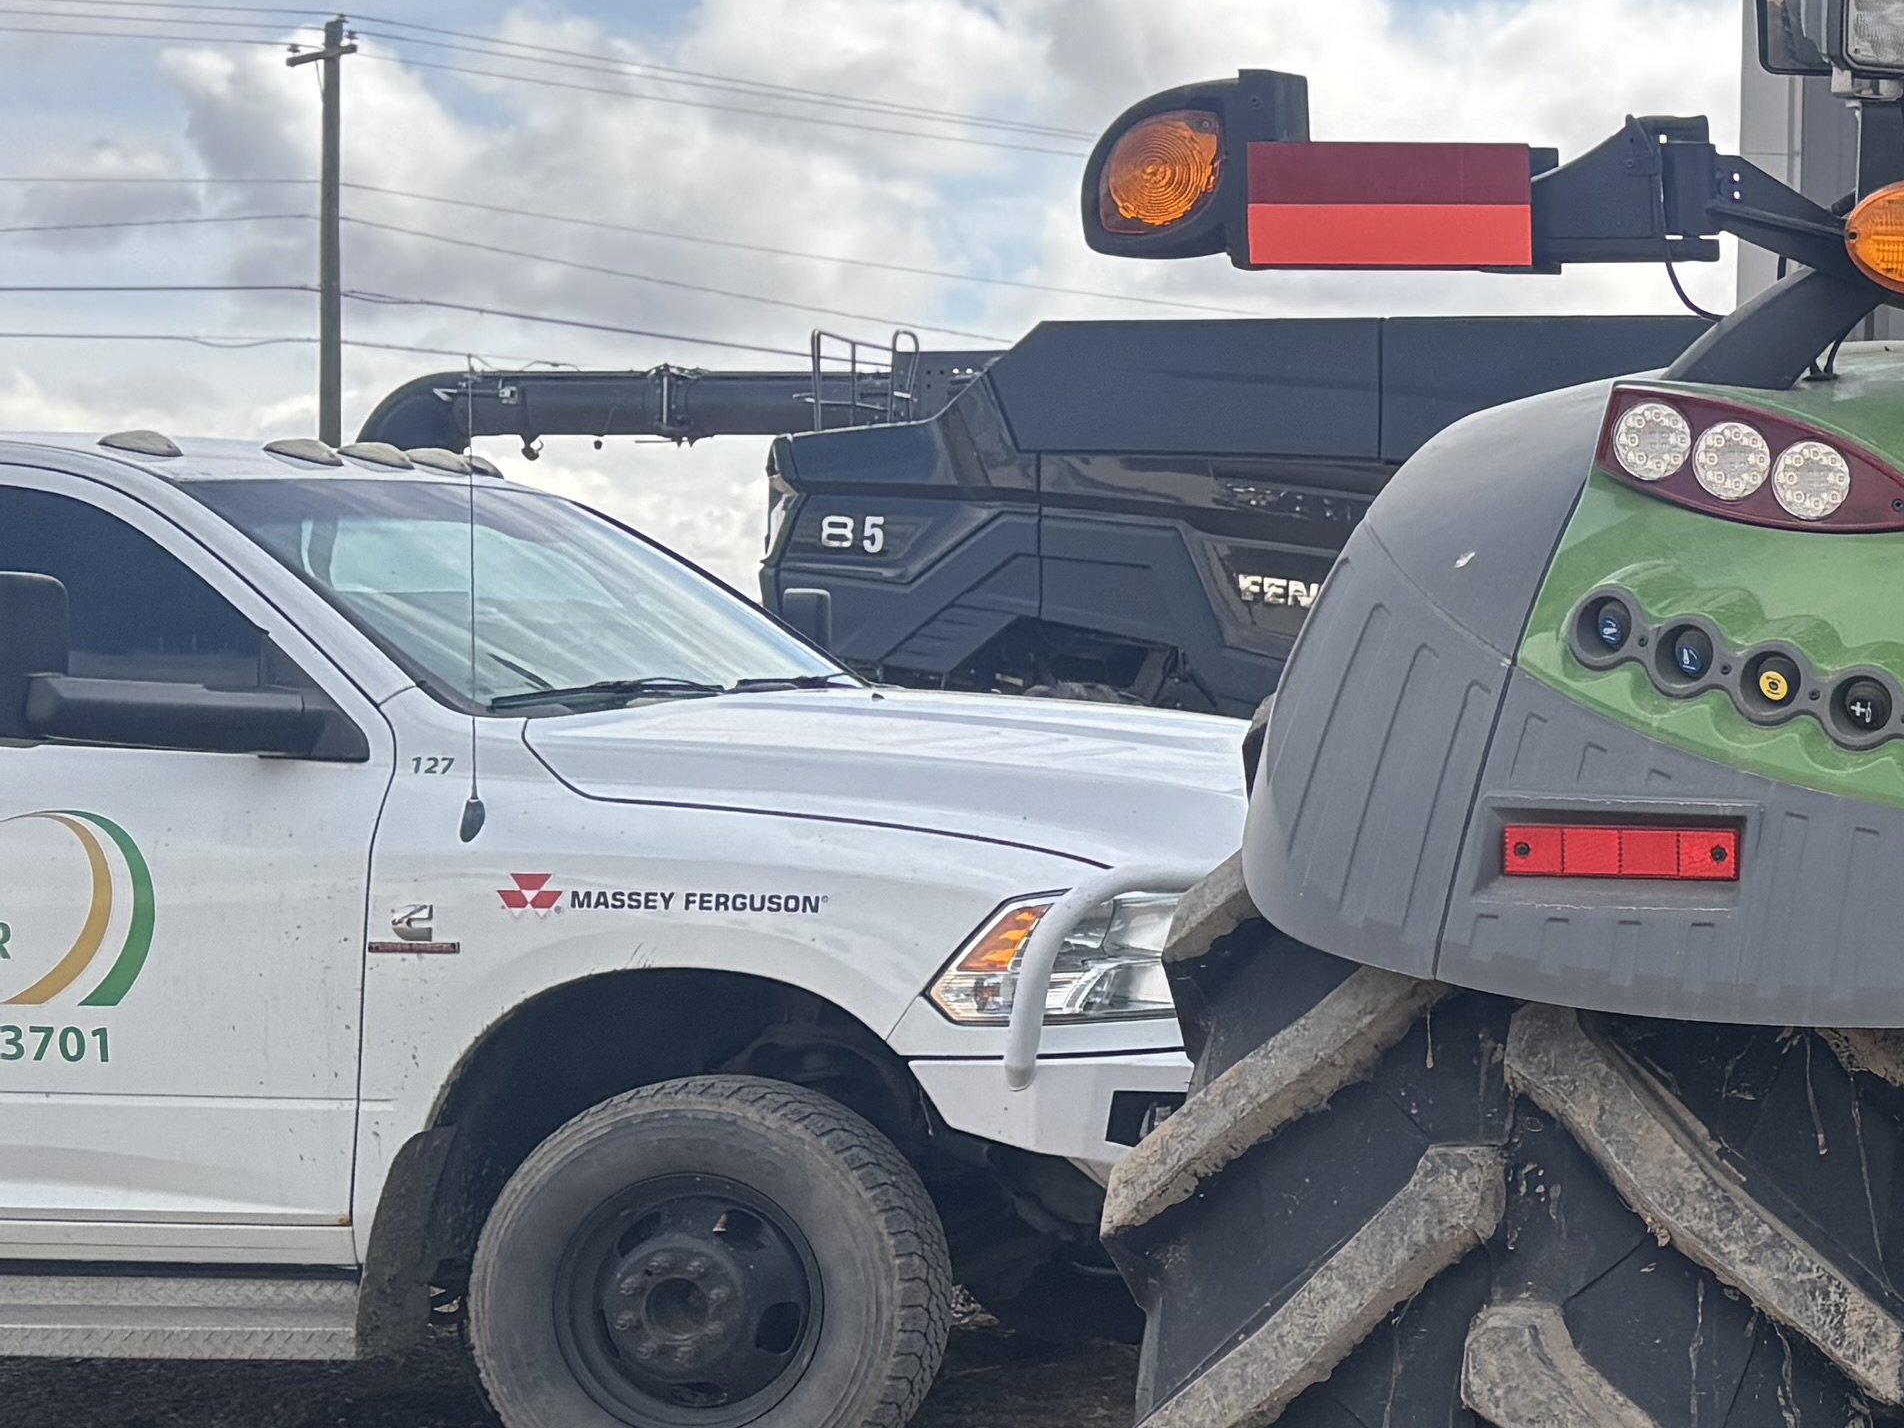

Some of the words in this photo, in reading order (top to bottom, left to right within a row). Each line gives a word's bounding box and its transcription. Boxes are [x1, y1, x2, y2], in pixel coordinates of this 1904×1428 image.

[411, 756, 455, 775] 127
[570, 890, 675, 911] MASSEY
[0, 1024, 110, 1063] 3701
